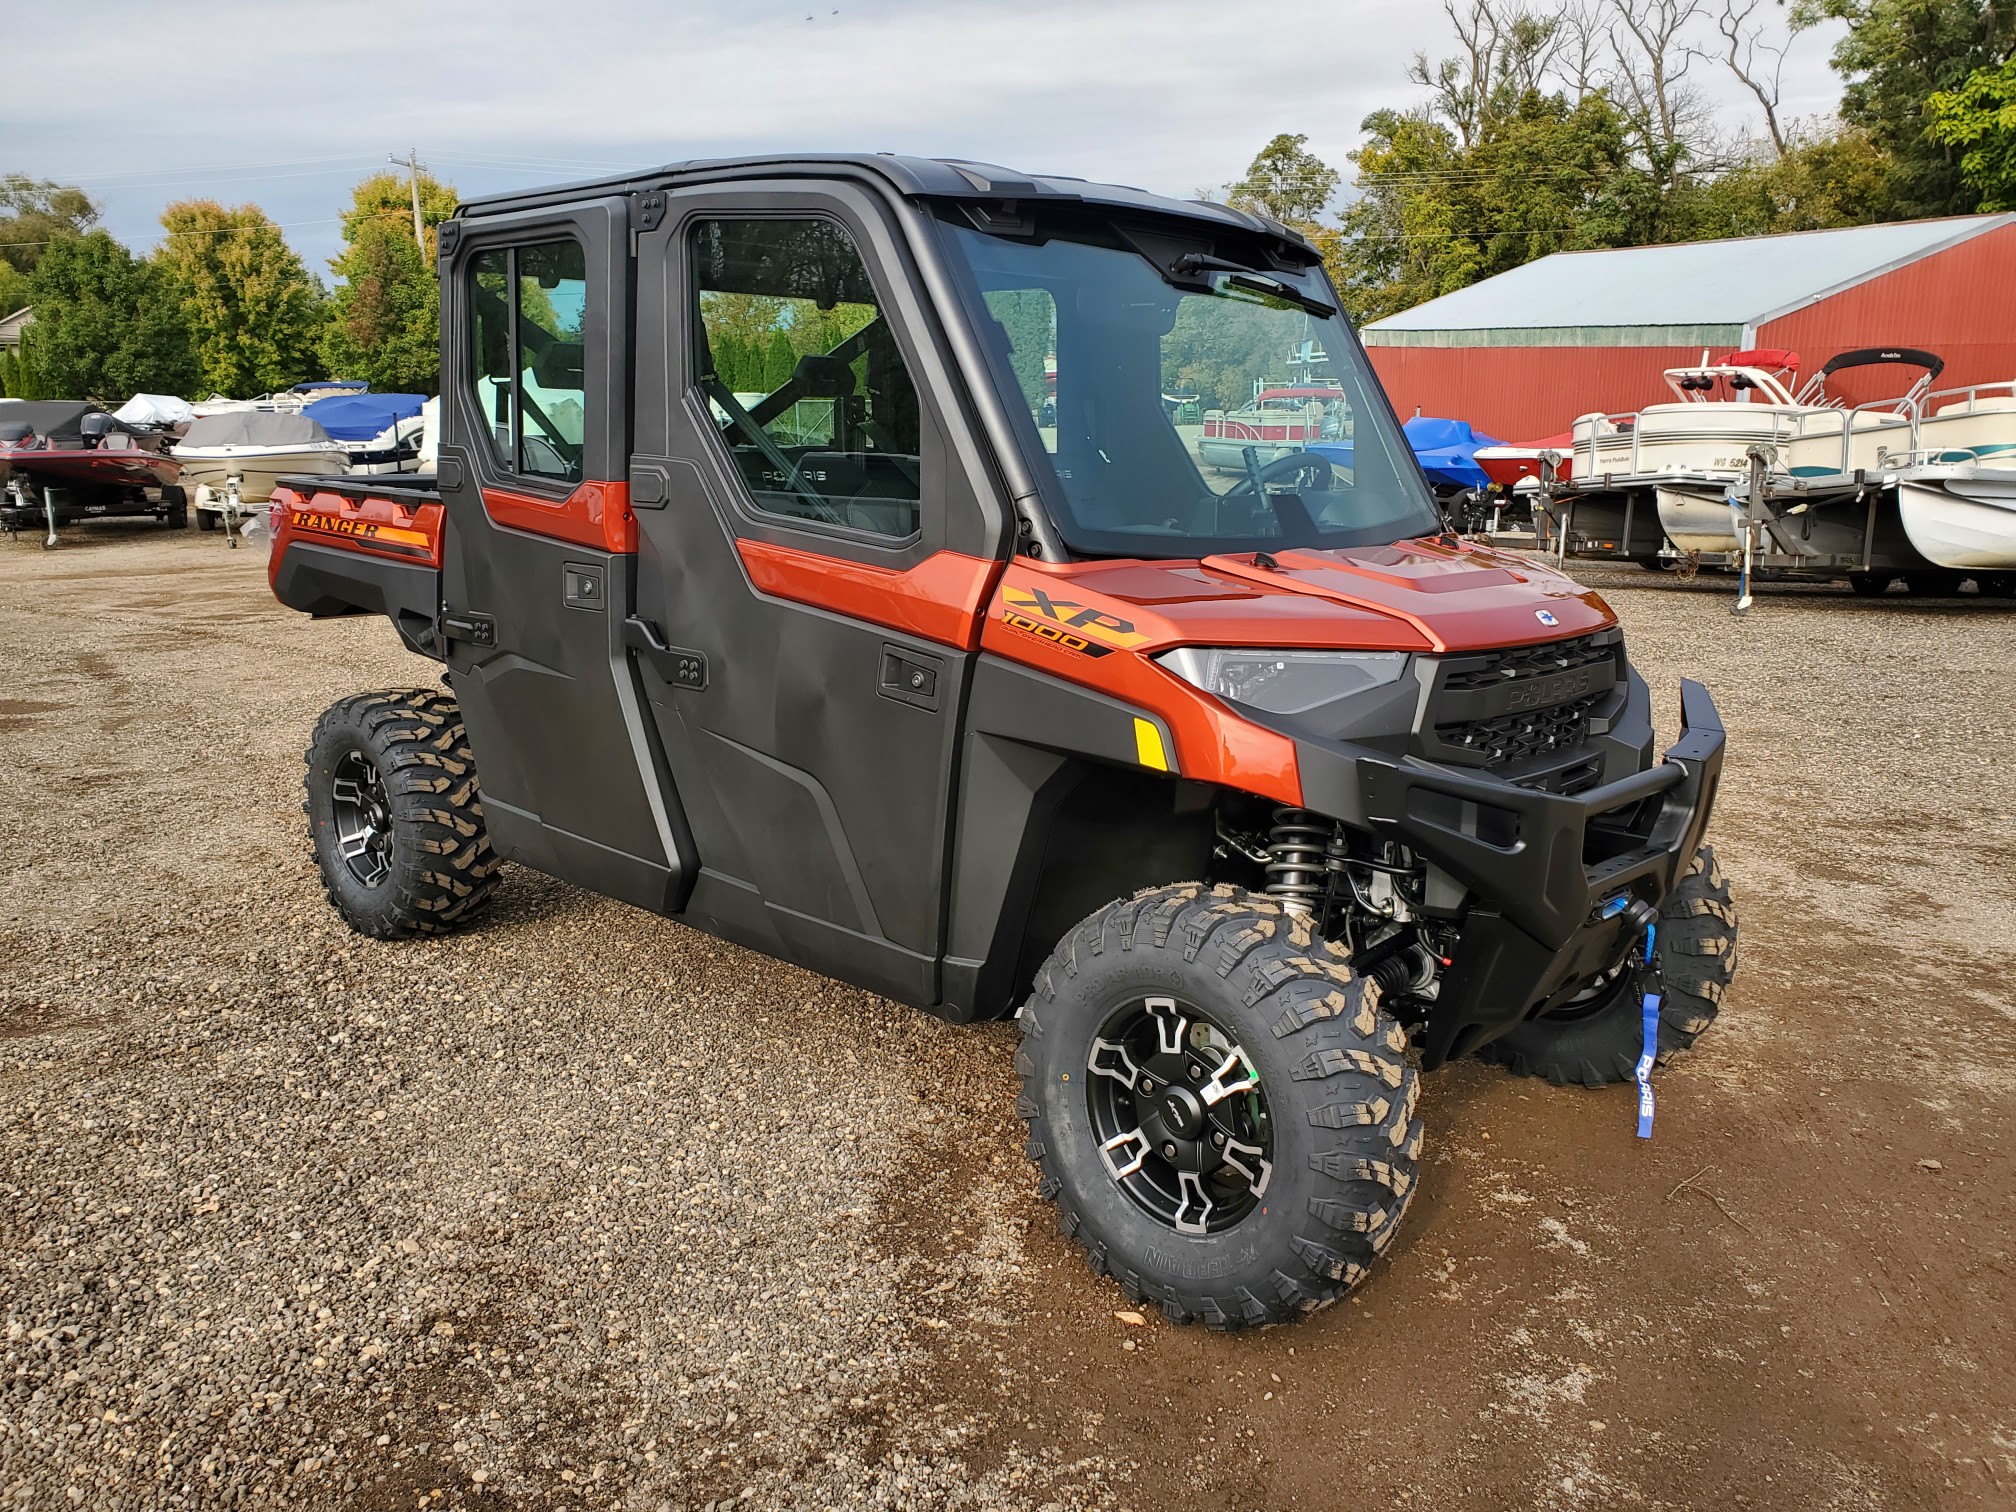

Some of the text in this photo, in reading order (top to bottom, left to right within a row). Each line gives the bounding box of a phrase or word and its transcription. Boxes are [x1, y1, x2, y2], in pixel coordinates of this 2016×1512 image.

[761, 470, 827, 481] PORIS
[297, 512, 380, 539] RANGER
[1005, 586, 1136, 634] XP
[1000, 625, 1020, 636] DUAL
[1001, 611, 1089, 651] 1000
[1506, 670, 1590, 711] POLARIS
[1636, 1054, 1655, 1117] POLARIS
